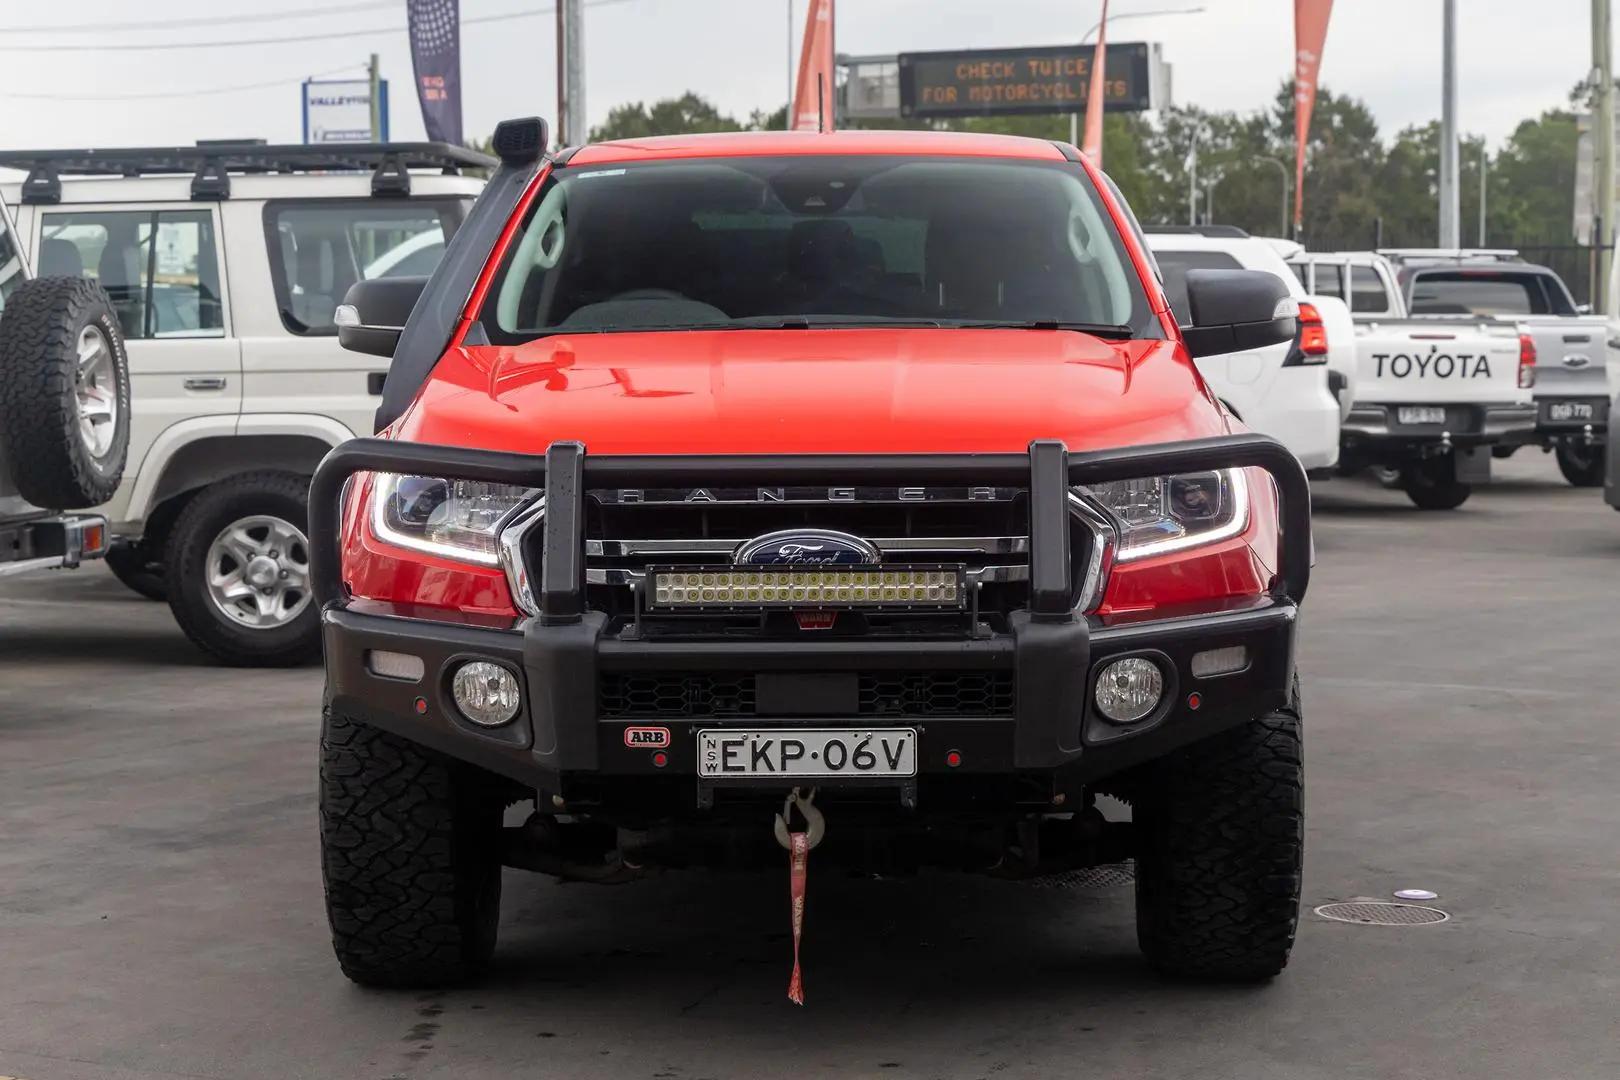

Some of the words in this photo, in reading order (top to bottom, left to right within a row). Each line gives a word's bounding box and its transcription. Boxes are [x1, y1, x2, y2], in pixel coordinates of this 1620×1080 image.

[956, 62, 1015, 80] CHECK
[1028, 58, 1088, 77] TWICE
[922, 86, 957, 102] FOR
[968, 80, 1127, 101] MOTORCYCLITS
[1372, 354, 1491, 378] TOYOTA
[617, 487, 996, 503] RANGER
[630, 731, 665, 743] ARB
[705, 739, 718, 773] NSW
